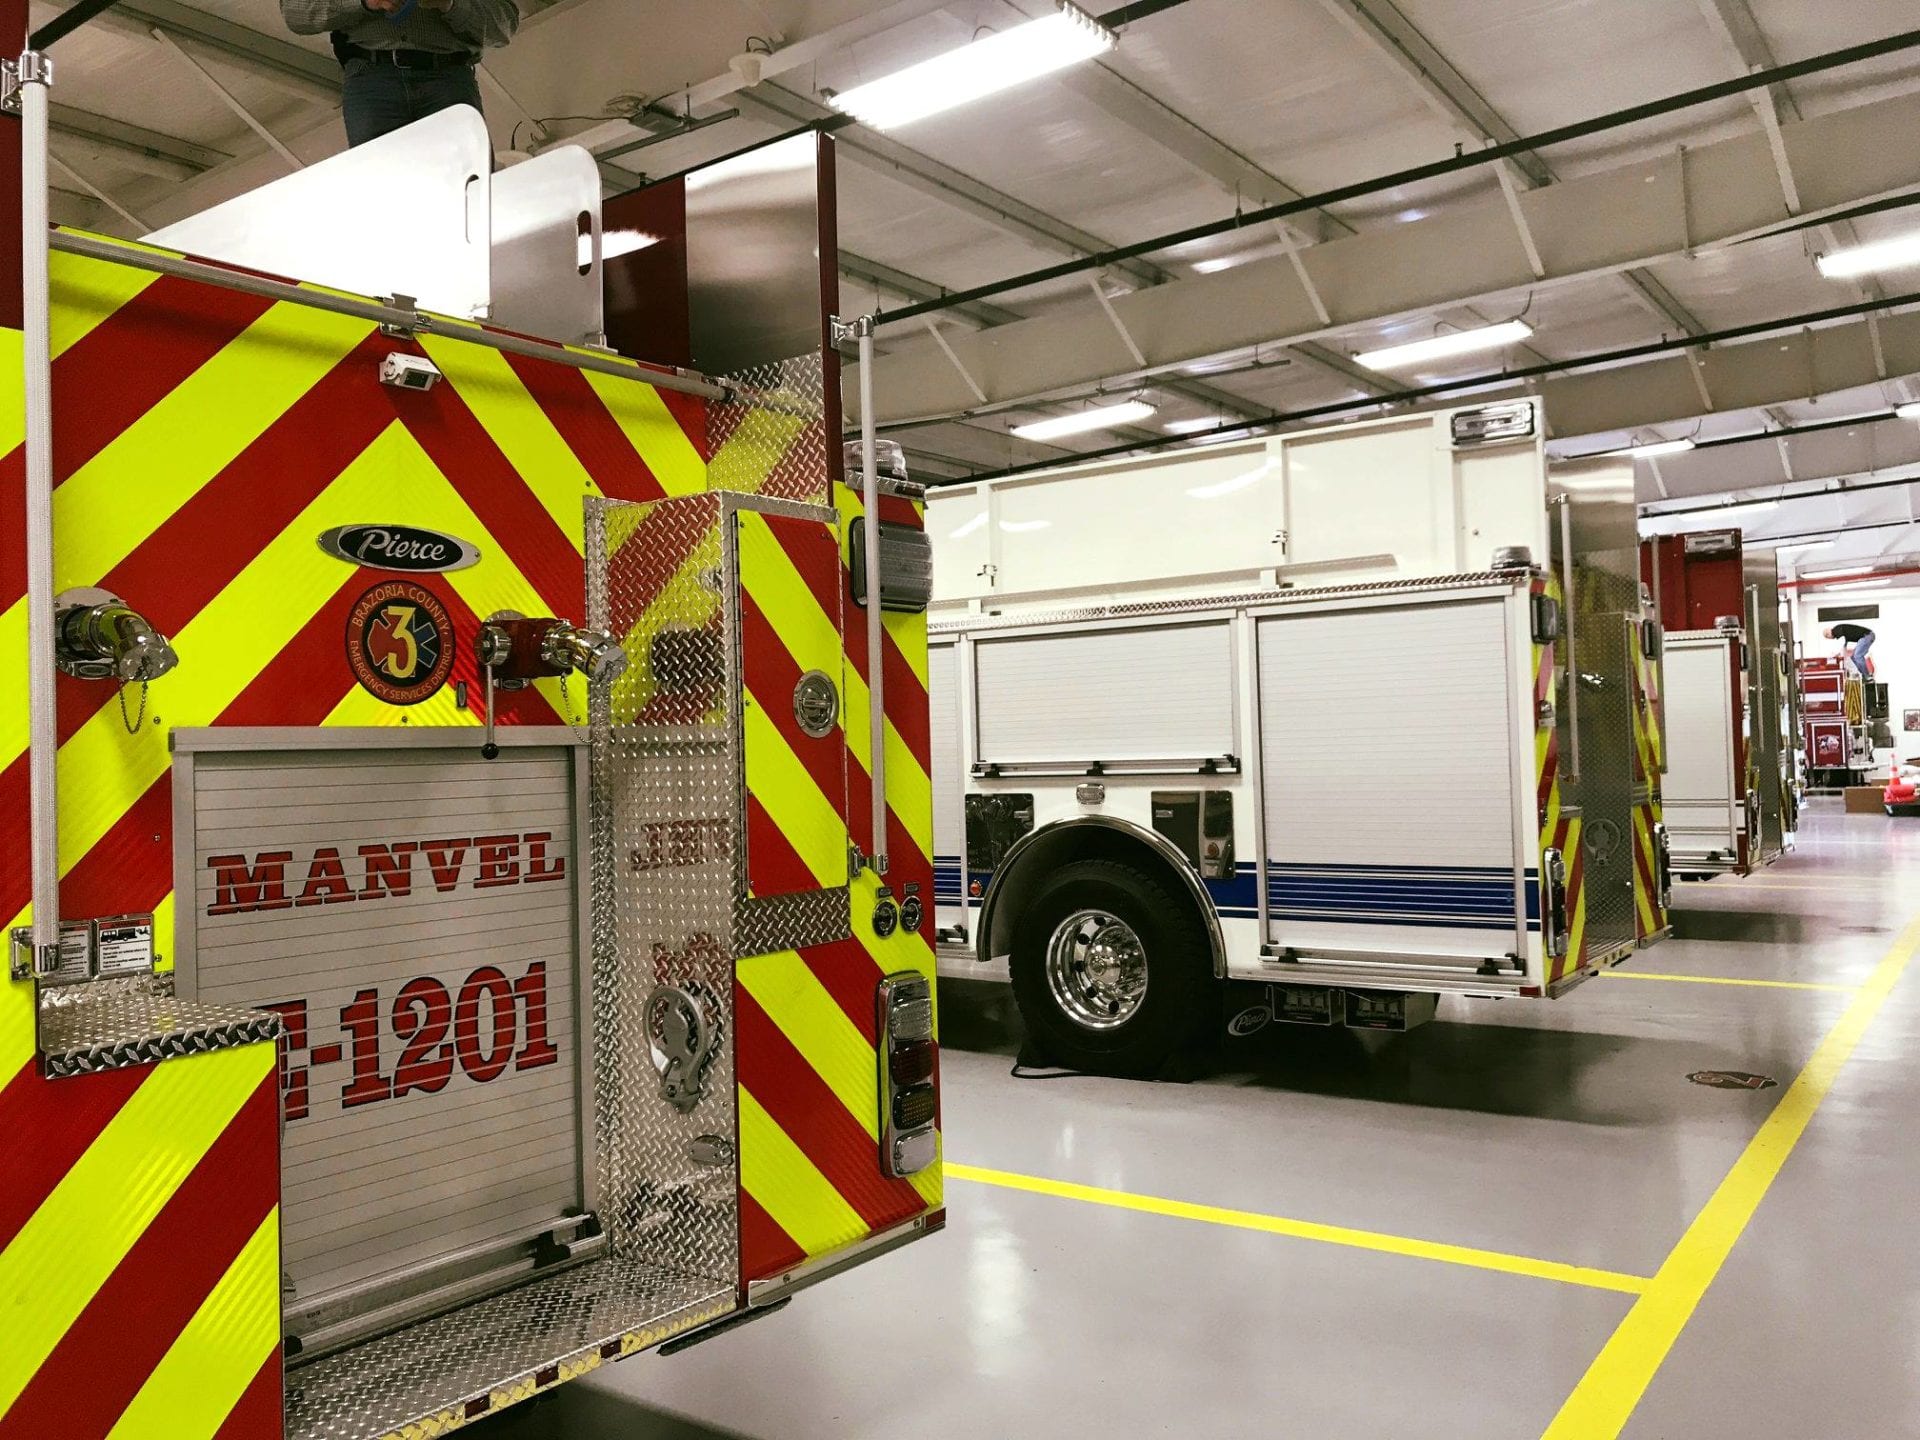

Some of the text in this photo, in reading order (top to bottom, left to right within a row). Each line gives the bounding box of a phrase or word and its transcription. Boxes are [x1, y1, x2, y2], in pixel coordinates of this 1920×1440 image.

[357, 529, 446, 561] Pierce
[351, 584, 405, 627] BRAZORIA
[350, 640, 452, 699] EMERGENCY SERVICES DISTRICT
[387, 605, 418, 678] 3
[207, 832, 566, 916] MANVEL
